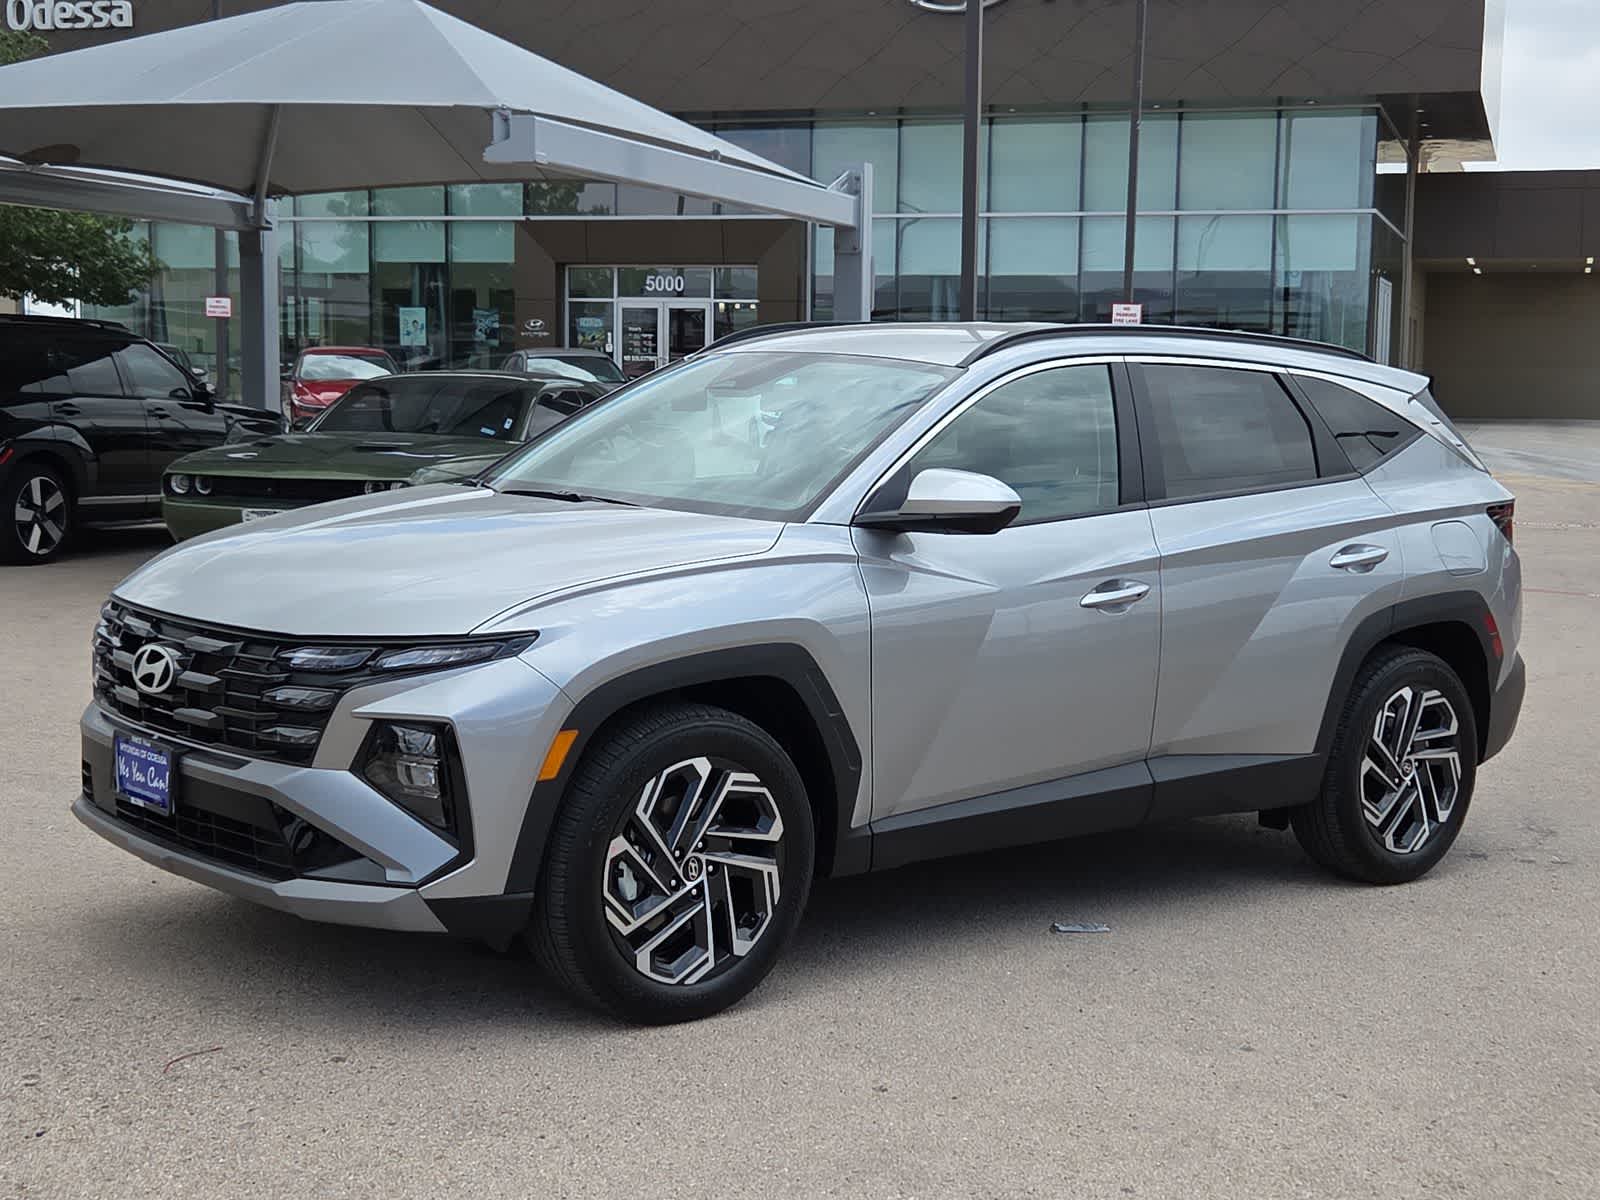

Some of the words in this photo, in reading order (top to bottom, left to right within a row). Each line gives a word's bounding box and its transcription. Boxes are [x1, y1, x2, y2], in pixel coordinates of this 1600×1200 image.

[6, 0, 133, 30] Odessa
[645, 275, 684, 292] 5000
[118, 755, 130, 778] Yes
[131, 760, 146, 784] You
[147, 766, 170, 792] Can!
